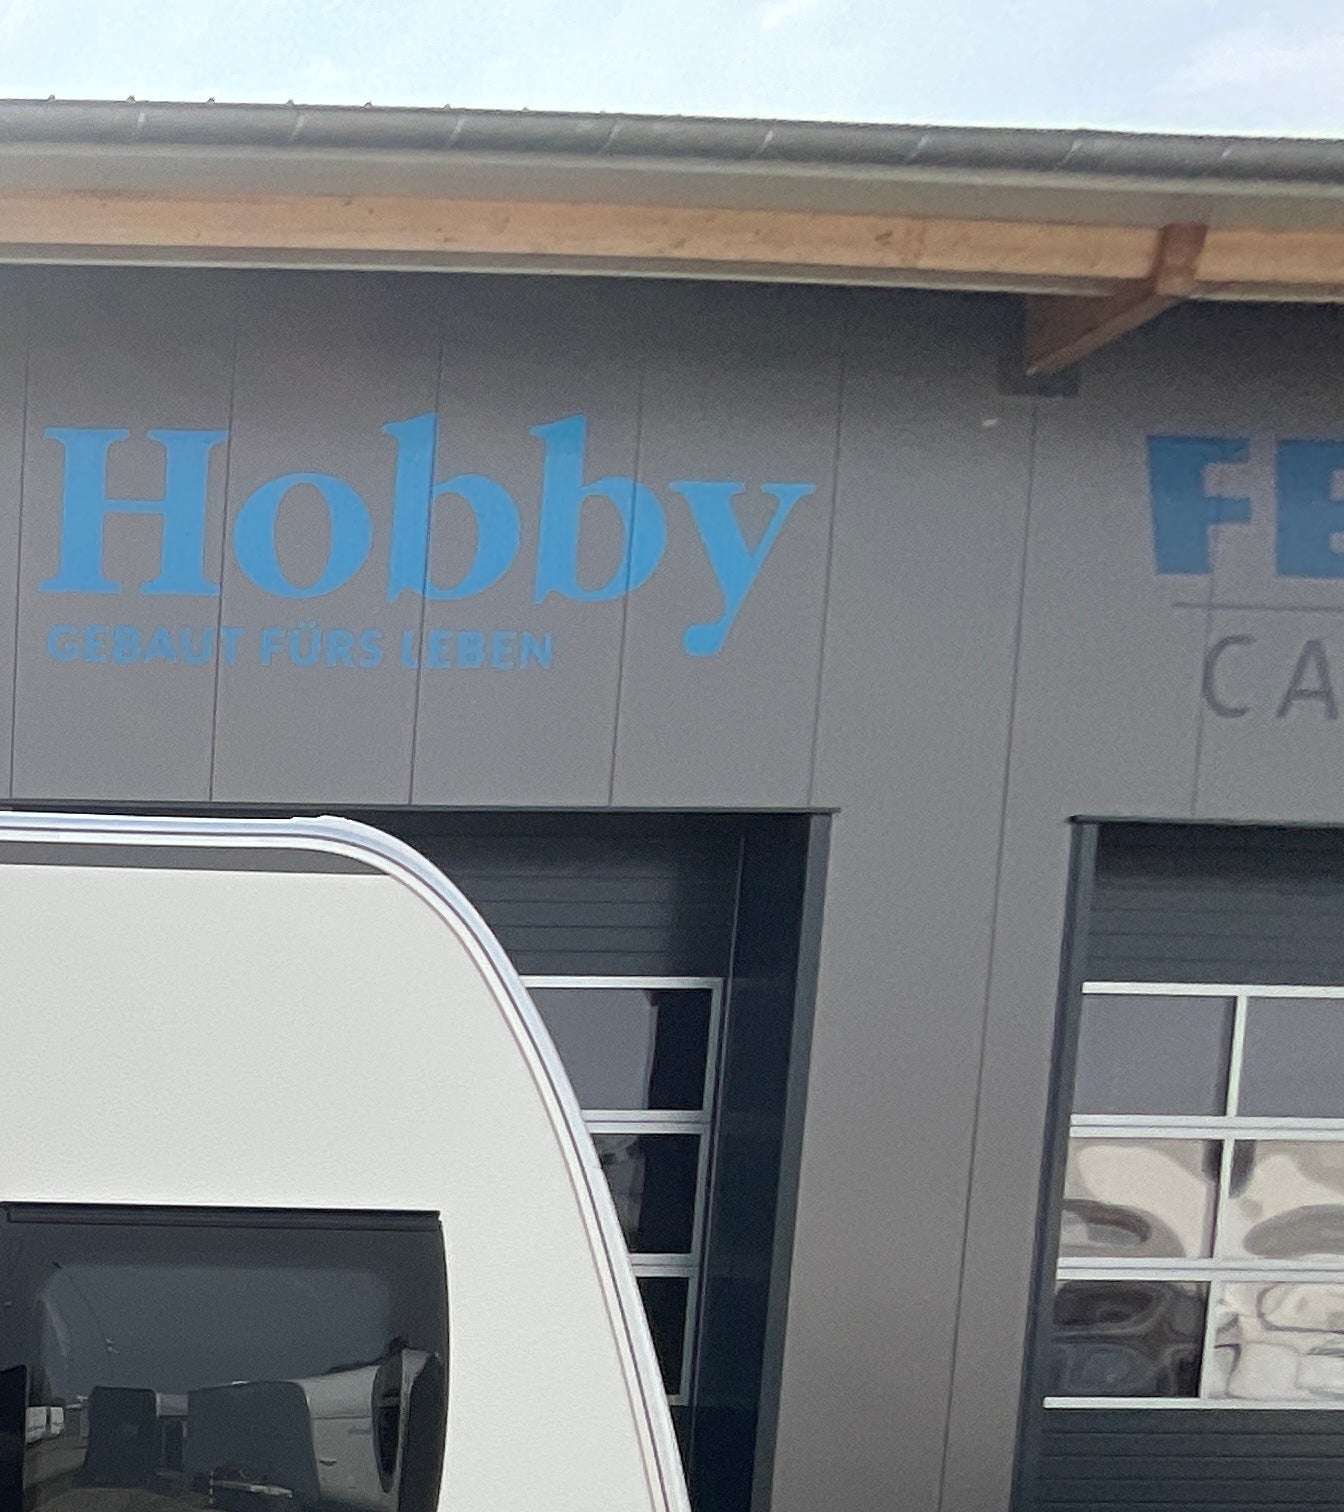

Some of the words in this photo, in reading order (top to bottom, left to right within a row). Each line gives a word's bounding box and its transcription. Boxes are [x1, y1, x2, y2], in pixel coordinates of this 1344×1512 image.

[36, 410, 817, 658] Hobby
[46, 623, 246, 666] GEBAUT
[259, 619, 385, 669] FÜRS
[400, 628, 554, 670] LEBEN
